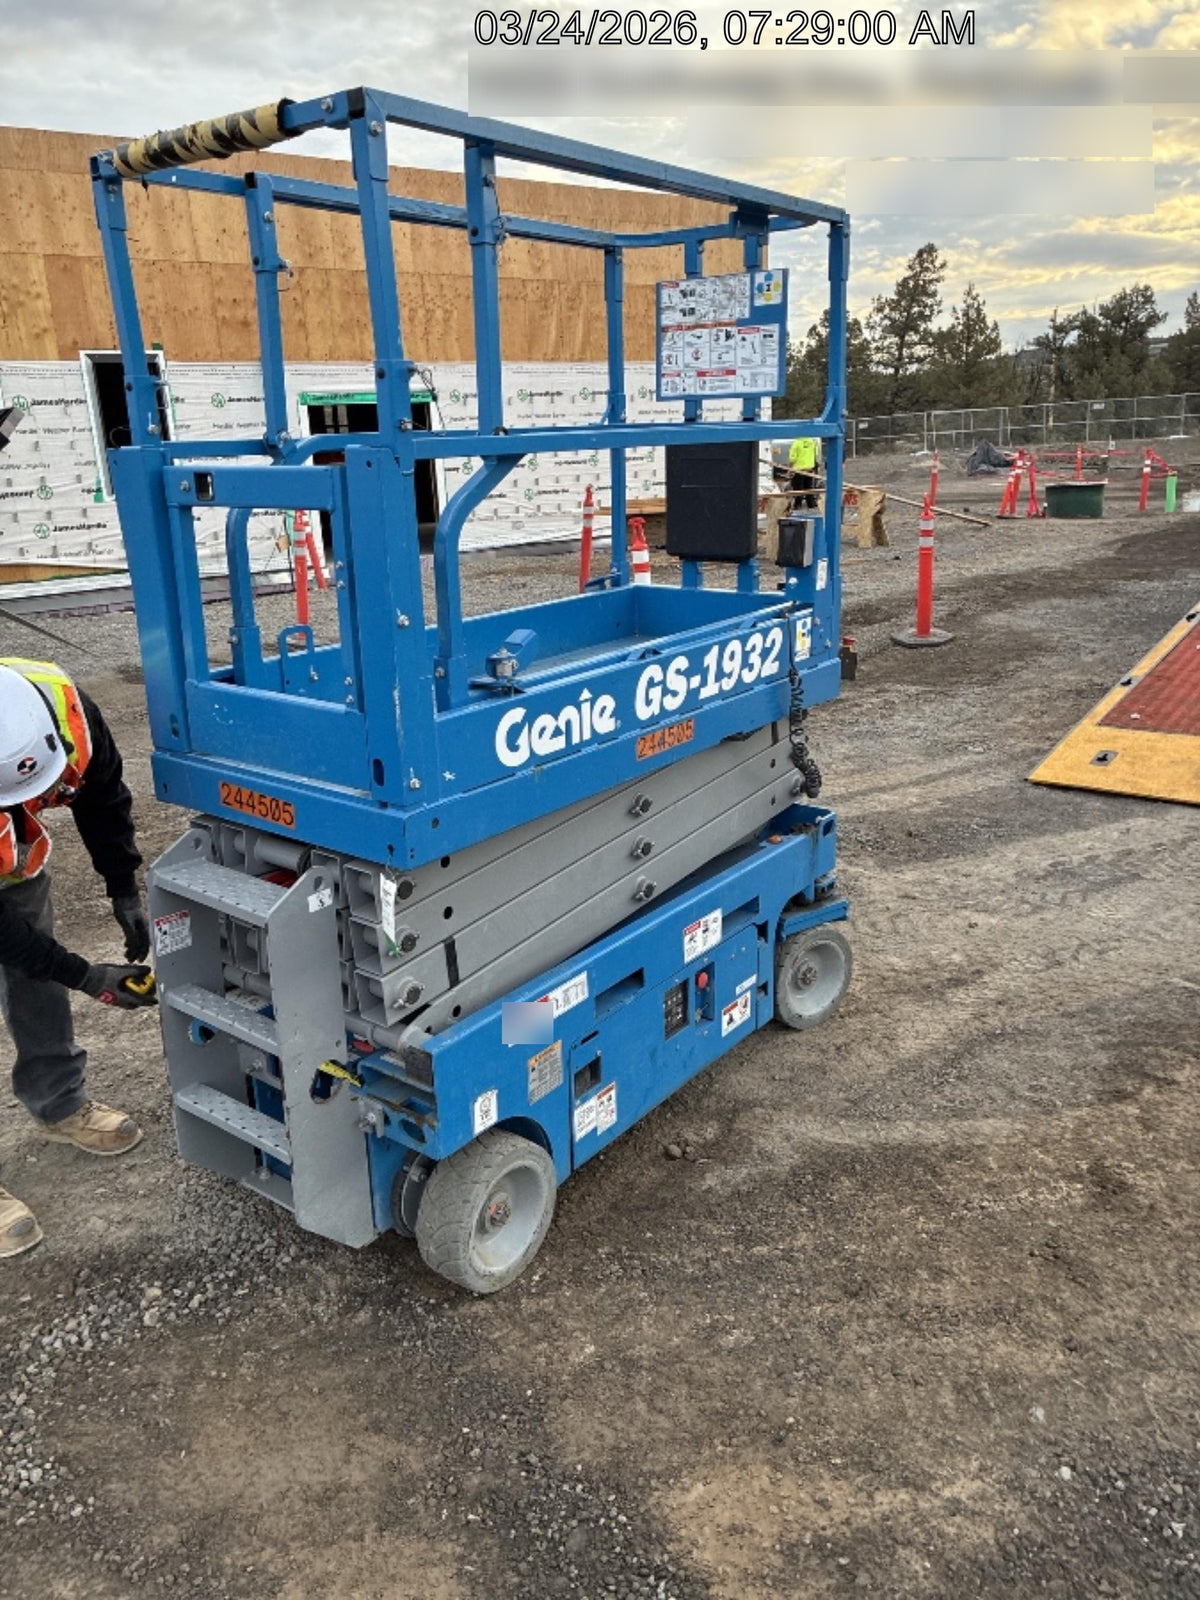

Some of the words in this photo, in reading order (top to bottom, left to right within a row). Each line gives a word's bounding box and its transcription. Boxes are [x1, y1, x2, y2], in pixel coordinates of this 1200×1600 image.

[494, 688, 617, 768] Genie
[633, 626, 783, 721] GS-1932
[637, 718, 693, 758] 244505
[221, 782, 294, 826] 244505
